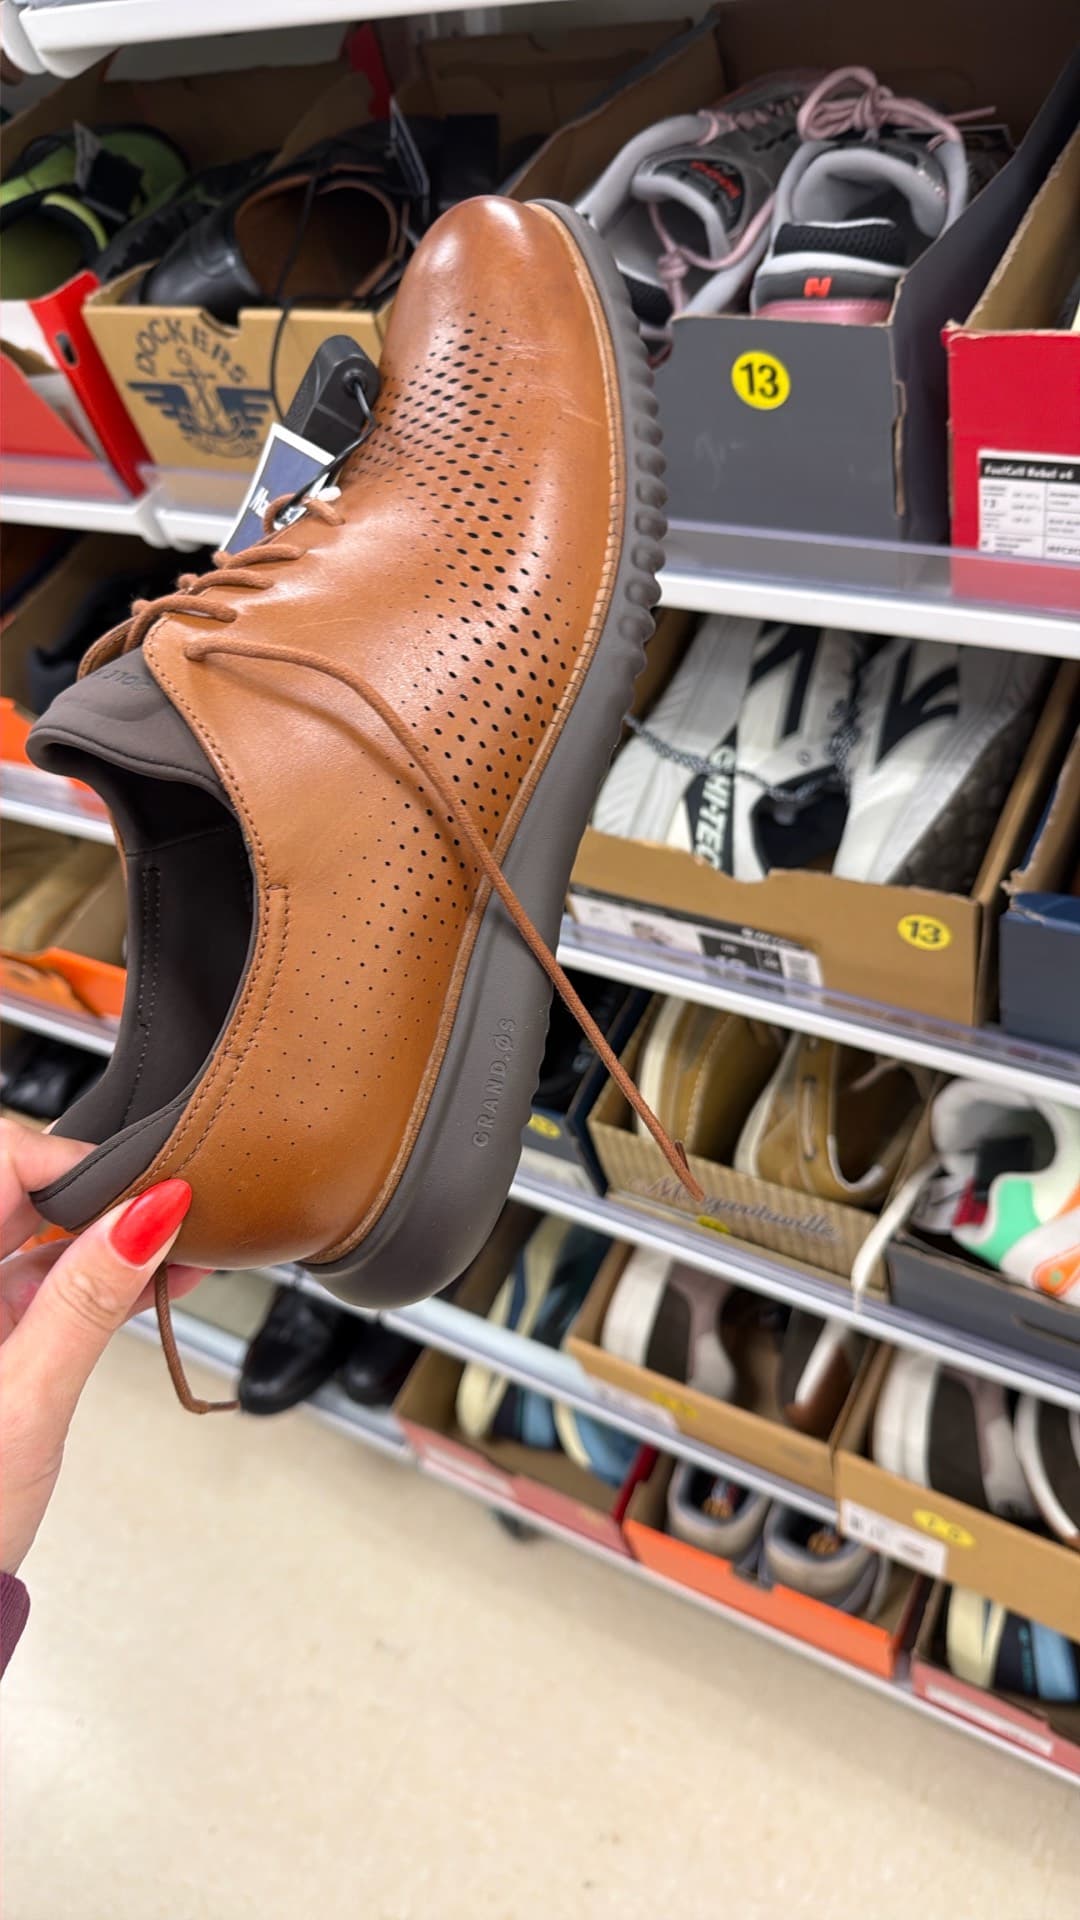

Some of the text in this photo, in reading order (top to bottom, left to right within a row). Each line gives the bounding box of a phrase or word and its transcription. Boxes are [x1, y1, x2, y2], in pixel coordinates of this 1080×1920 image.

[134, 317, 249, 384] DOCKERS
[739, 362, 781, 400] 13
[904, 920, 942, 945] 13
